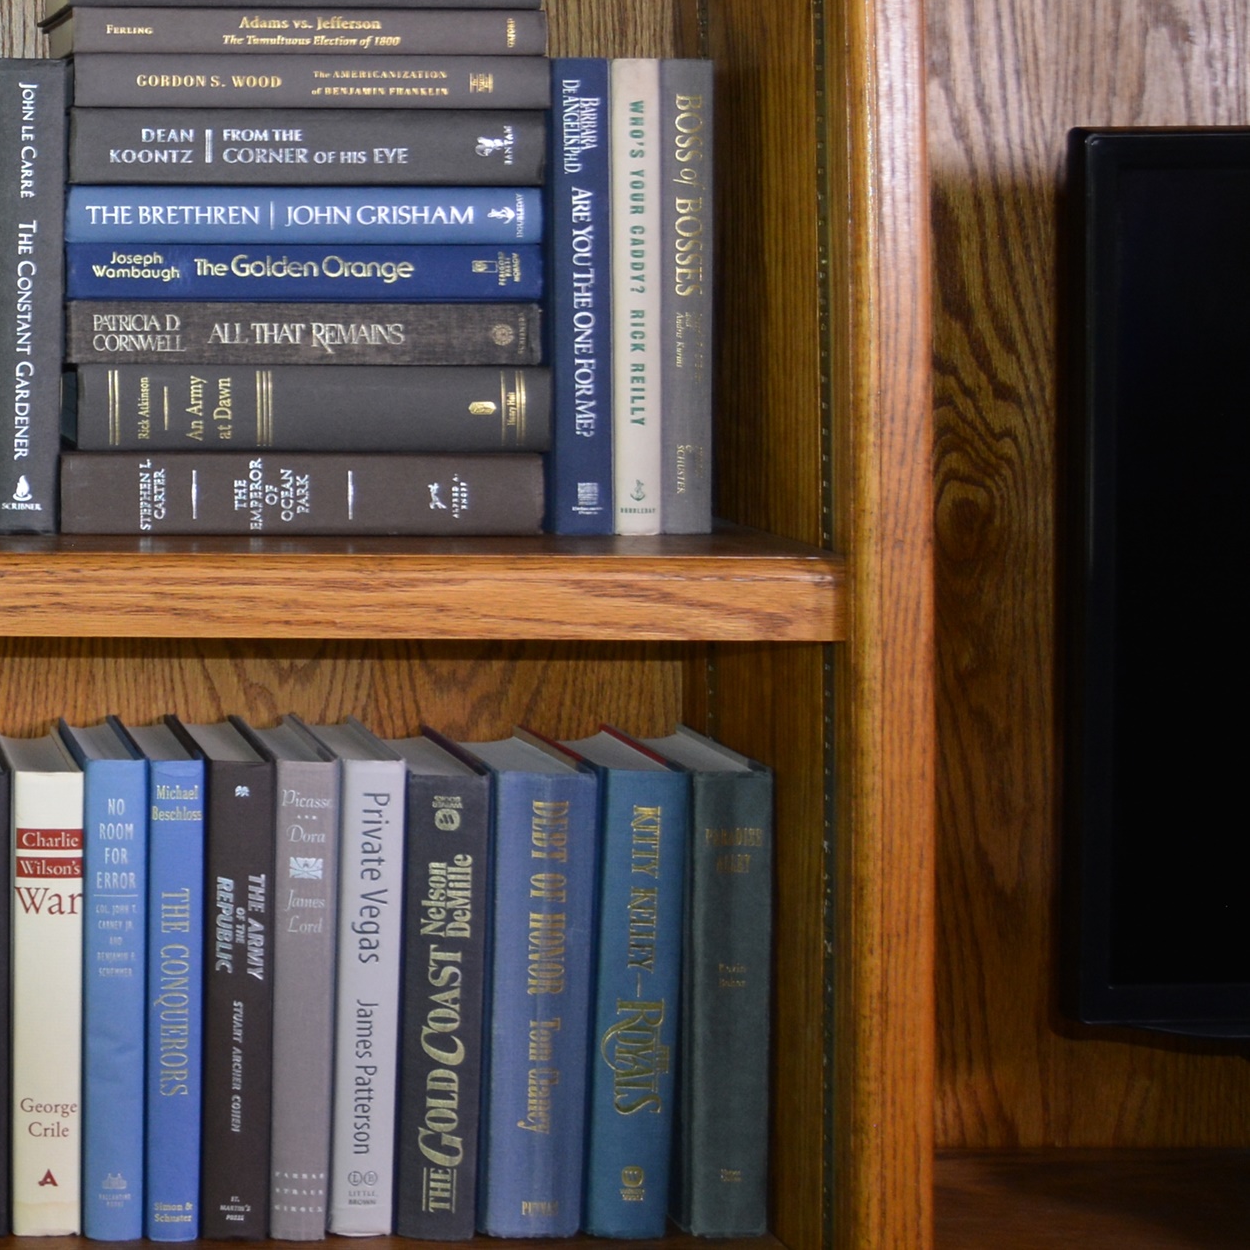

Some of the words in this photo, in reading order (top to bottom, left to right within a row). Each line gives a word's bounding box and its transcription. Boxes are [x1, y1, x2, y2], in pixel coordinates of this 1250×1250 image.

[19, 83, 38, 119] JOHN
[20, 124, 36, 140] LE
[141, 128, 194, 142] DEAN
[629, 101, 645, 159] WHO'S
[20, 145, 38, 199] CARRÉ
[109, 150, 193, 164] KOONTZ
[629, 170, 645, 215] YOUR
[86, 205, 133, 225] THE
[138, 205, 260, 225] BRETHREN
[285, 205, 352, 228] JOHN
[357, 205, 474, 225] GRISHAM
[194, 258, 227, 277] The
[230, 255, 319, 278] Golden
[322, 256, 415, 283] Orange
[630, 226, 646, 295] CADDY?
[22, 832, 79, 848] Charlie
[361, 792, 391, 882] Private
[20, 860, 82, 875] Wilson's
[16, 886, 83, 916] War
[161, 888, 191, 932] THE
[352, 888, 388, 964] Vegas
[154, 944, 191, 1097] CONQUERORS
[356, 1000, 377, 1057] James
[20, 1099, 77, 1117] George
[354, 1060, 376, 1156] Patterson
[28, 1122, 69, 1138] Crile
